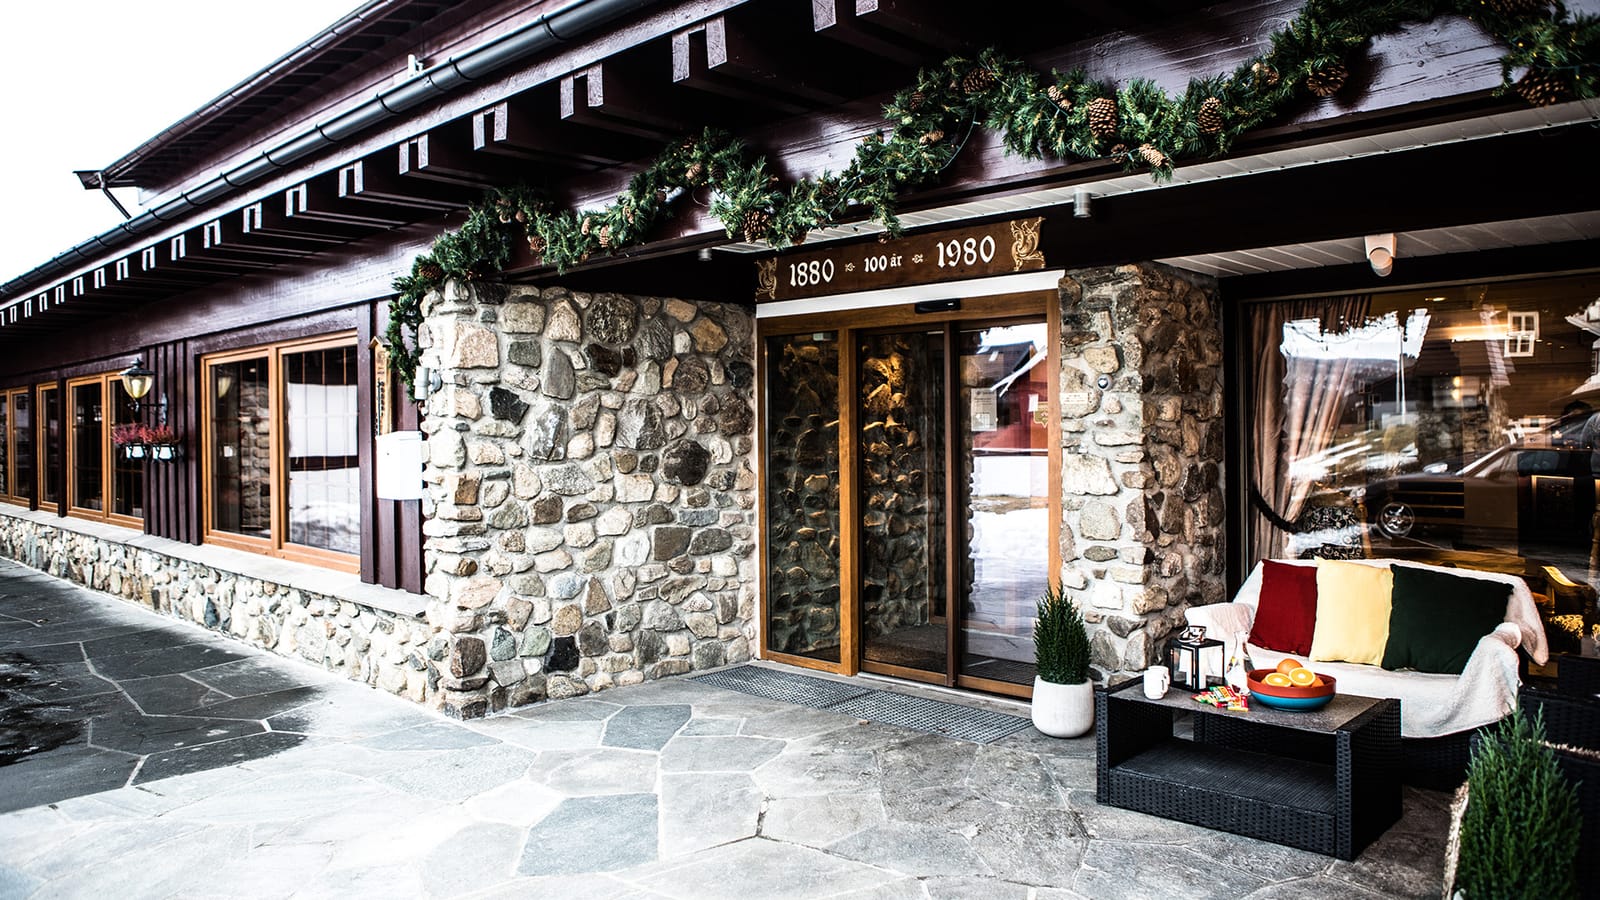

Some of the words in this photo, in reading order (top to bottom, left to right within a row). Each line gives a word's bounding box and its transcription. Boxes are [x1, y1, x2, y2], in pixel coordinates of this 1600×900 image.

[789, 258, 835, 287] 1880
[864, 255, 888, 273] 100
[890, 253, 903, 268] år
[936, 235, 996, 269] 1980
